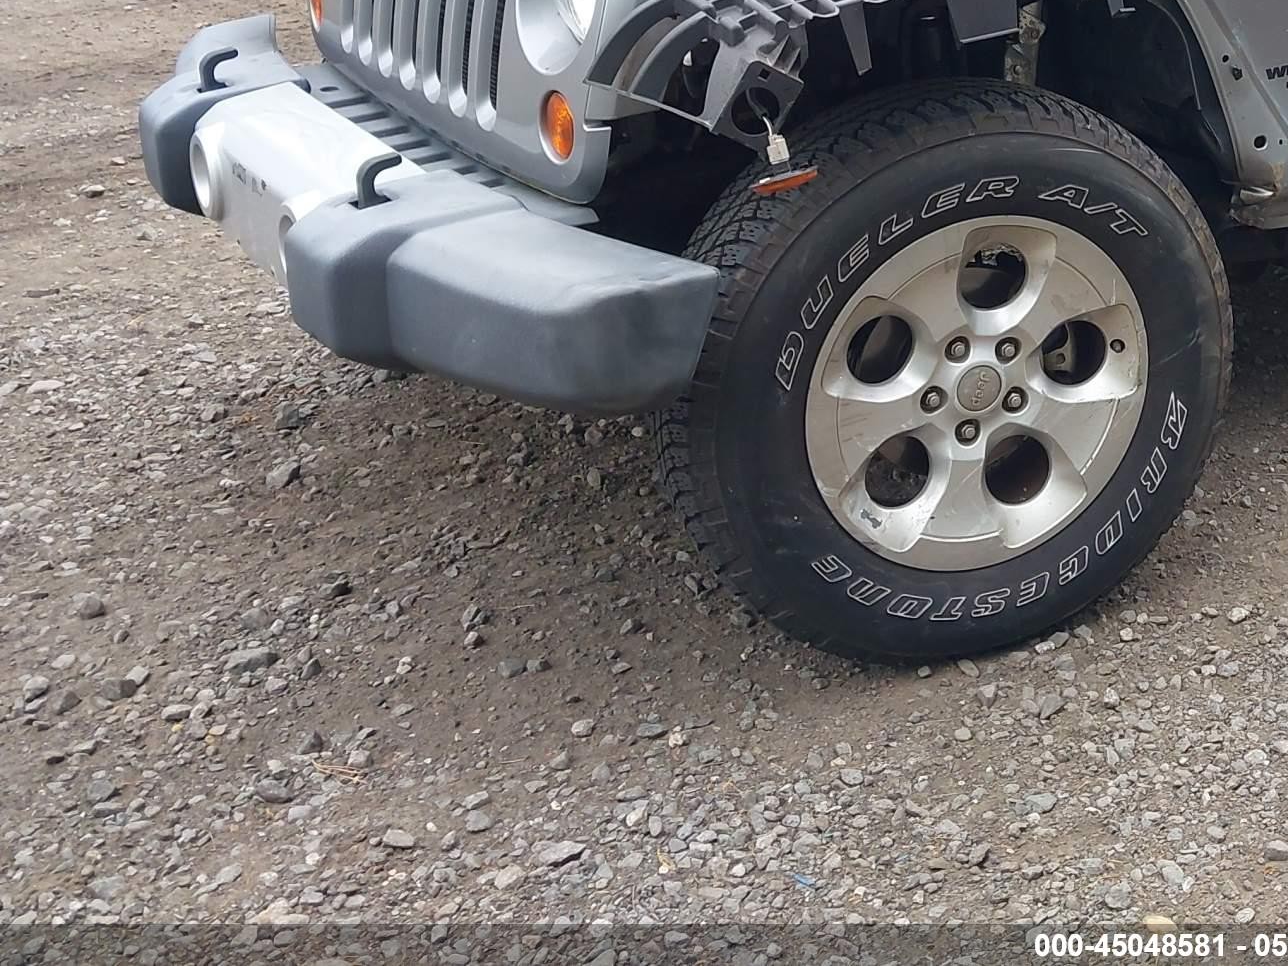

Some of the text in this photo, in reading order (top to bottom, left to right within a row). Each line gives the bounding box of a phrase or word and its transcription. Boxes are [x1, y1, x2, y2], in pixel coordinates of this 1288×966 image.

[776, 175, 1148, 391] DUELER A/T
[811, 391, 1188, 621] BRIDGESTONE
